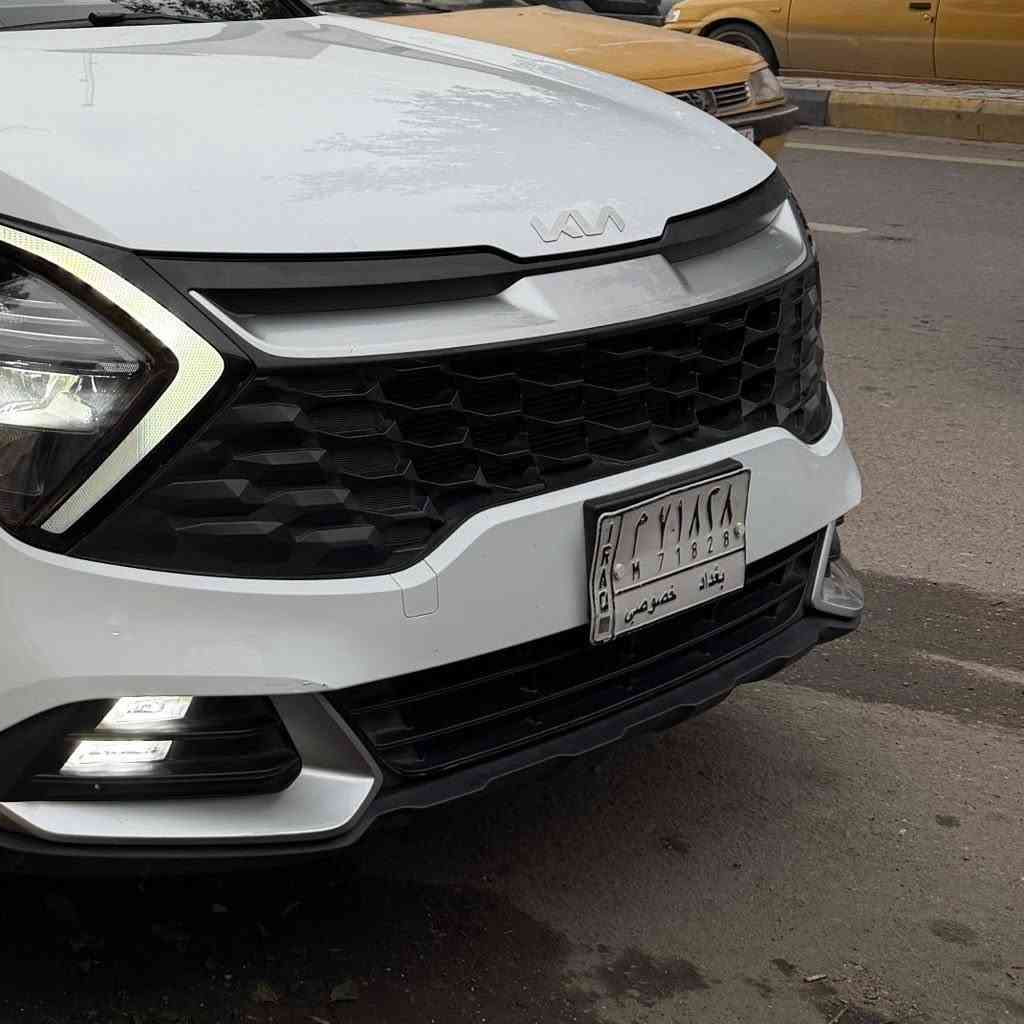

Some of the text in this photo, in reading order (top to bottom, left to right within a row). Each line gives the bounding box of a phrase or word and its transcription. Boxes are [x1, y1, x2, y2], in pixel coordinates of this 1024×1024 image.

[598, 523, 615, 613] IRAQ
[656, 529, 730, 572] 71828
[624, 566, 726, 624] بغداد خصوصي
